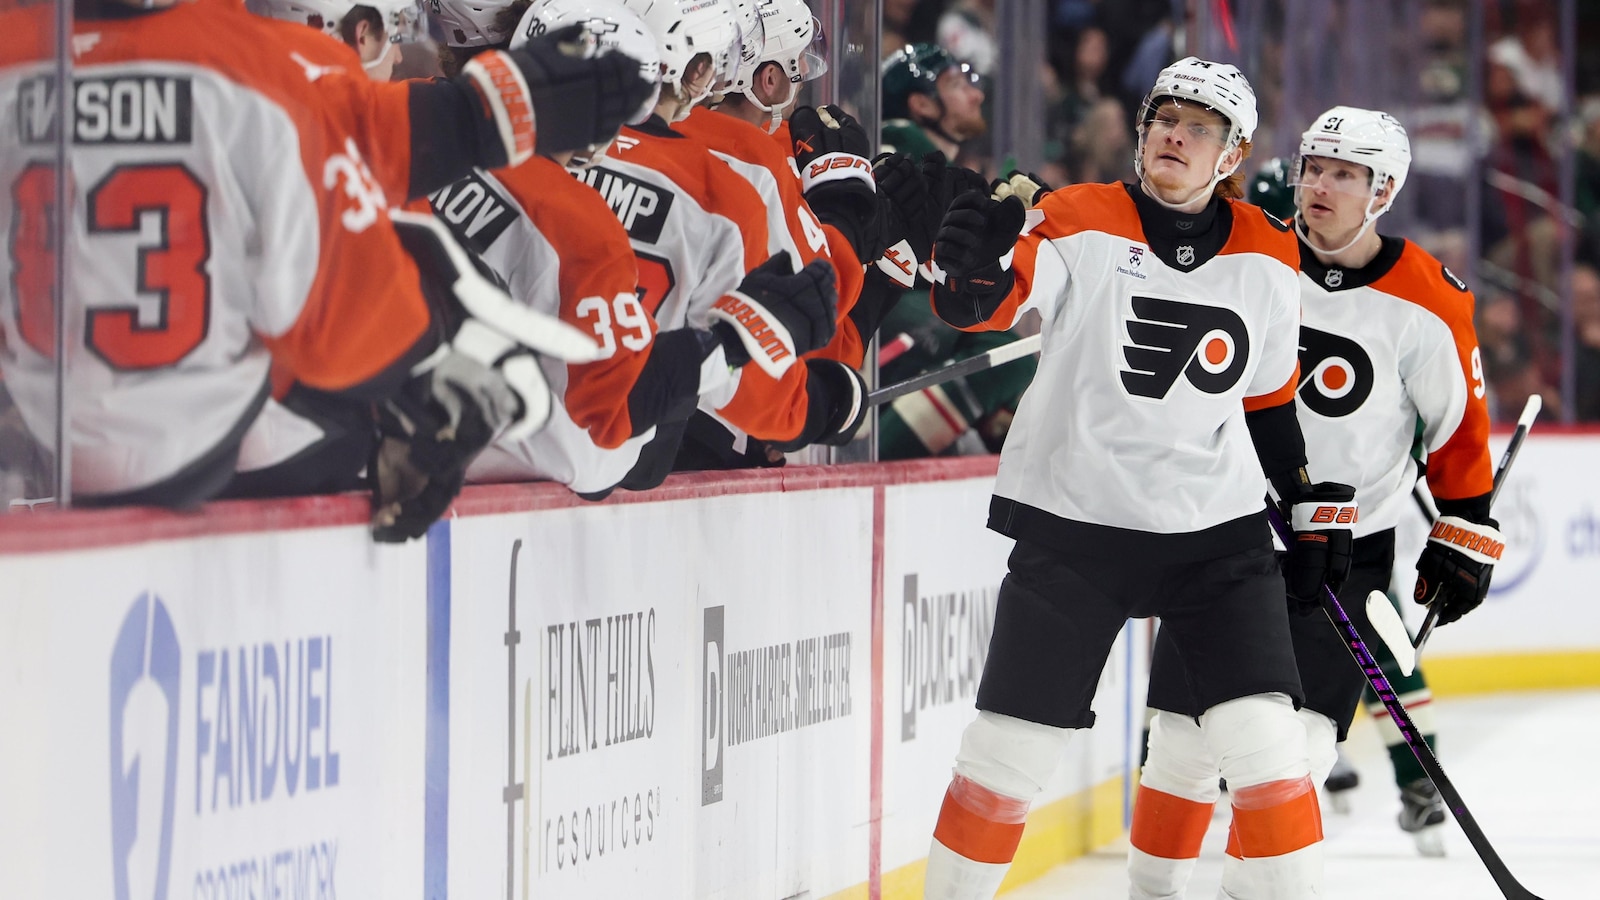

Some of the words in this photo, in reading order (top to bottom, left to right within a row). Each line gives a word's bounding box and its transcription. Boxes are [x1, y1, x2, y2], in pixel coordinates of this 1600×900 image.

[1324, 117, 1344, 131] 91
[576, 292, 652, 359] 39
[546, 618, 602, 761] FLINT
[605, 607, 656, 747] HILLS
[727, 650, 755, 747] WORK
[794, 637, 821, 730] SMELL
[920, 592, 955, 710] DUKE
[195, 634, 340, 817] FANDUEL
